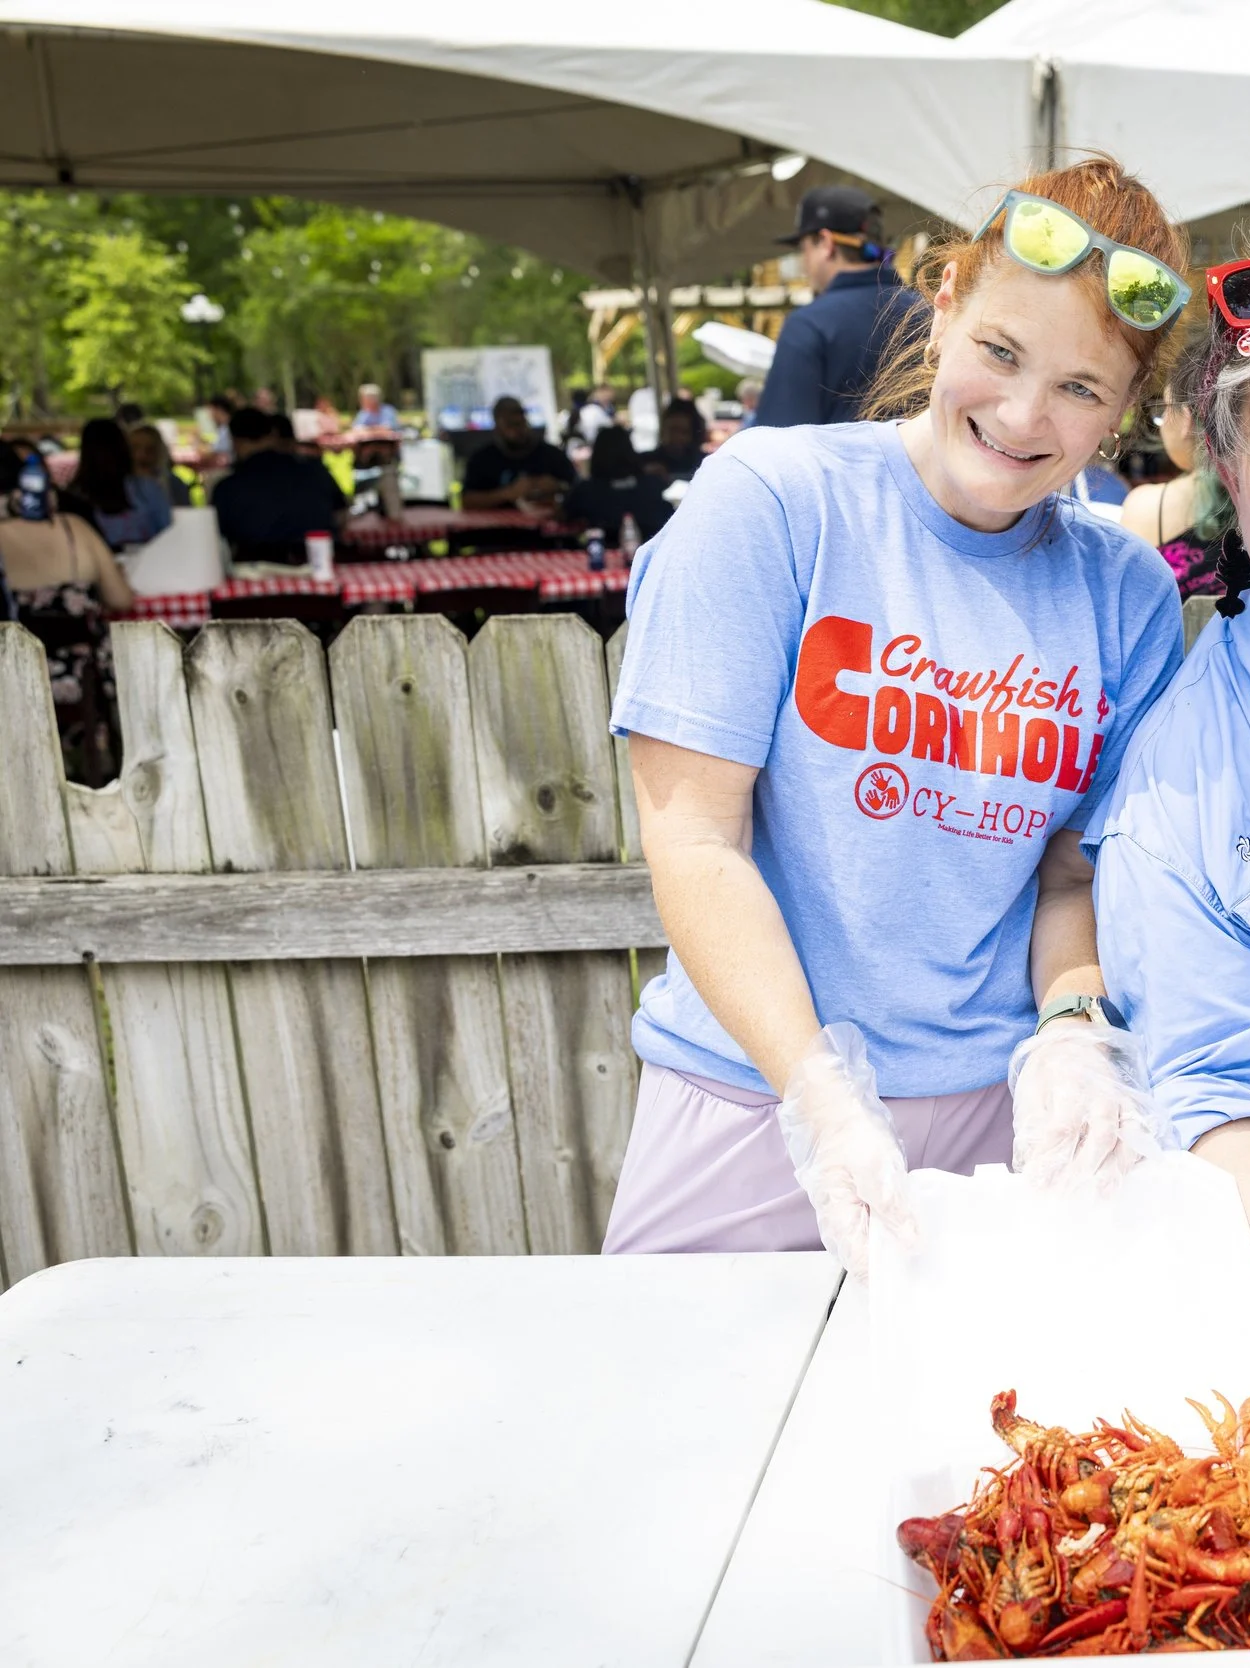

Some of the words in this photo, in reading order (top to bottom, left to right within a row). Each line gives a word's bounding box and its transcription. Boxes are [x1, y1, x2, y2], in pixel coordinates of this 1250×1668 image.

[880, 634, 1083, 718] Crawfish
[912, 787, 1055, 840] CY-HOP
[937, 823, 961, 836] Making
[962, 829, 975, 838] Life
[974, 831, 992, 841] Better
[992, 834, 1002, 843] for
[1001, 836, 1014, 845] Kids
